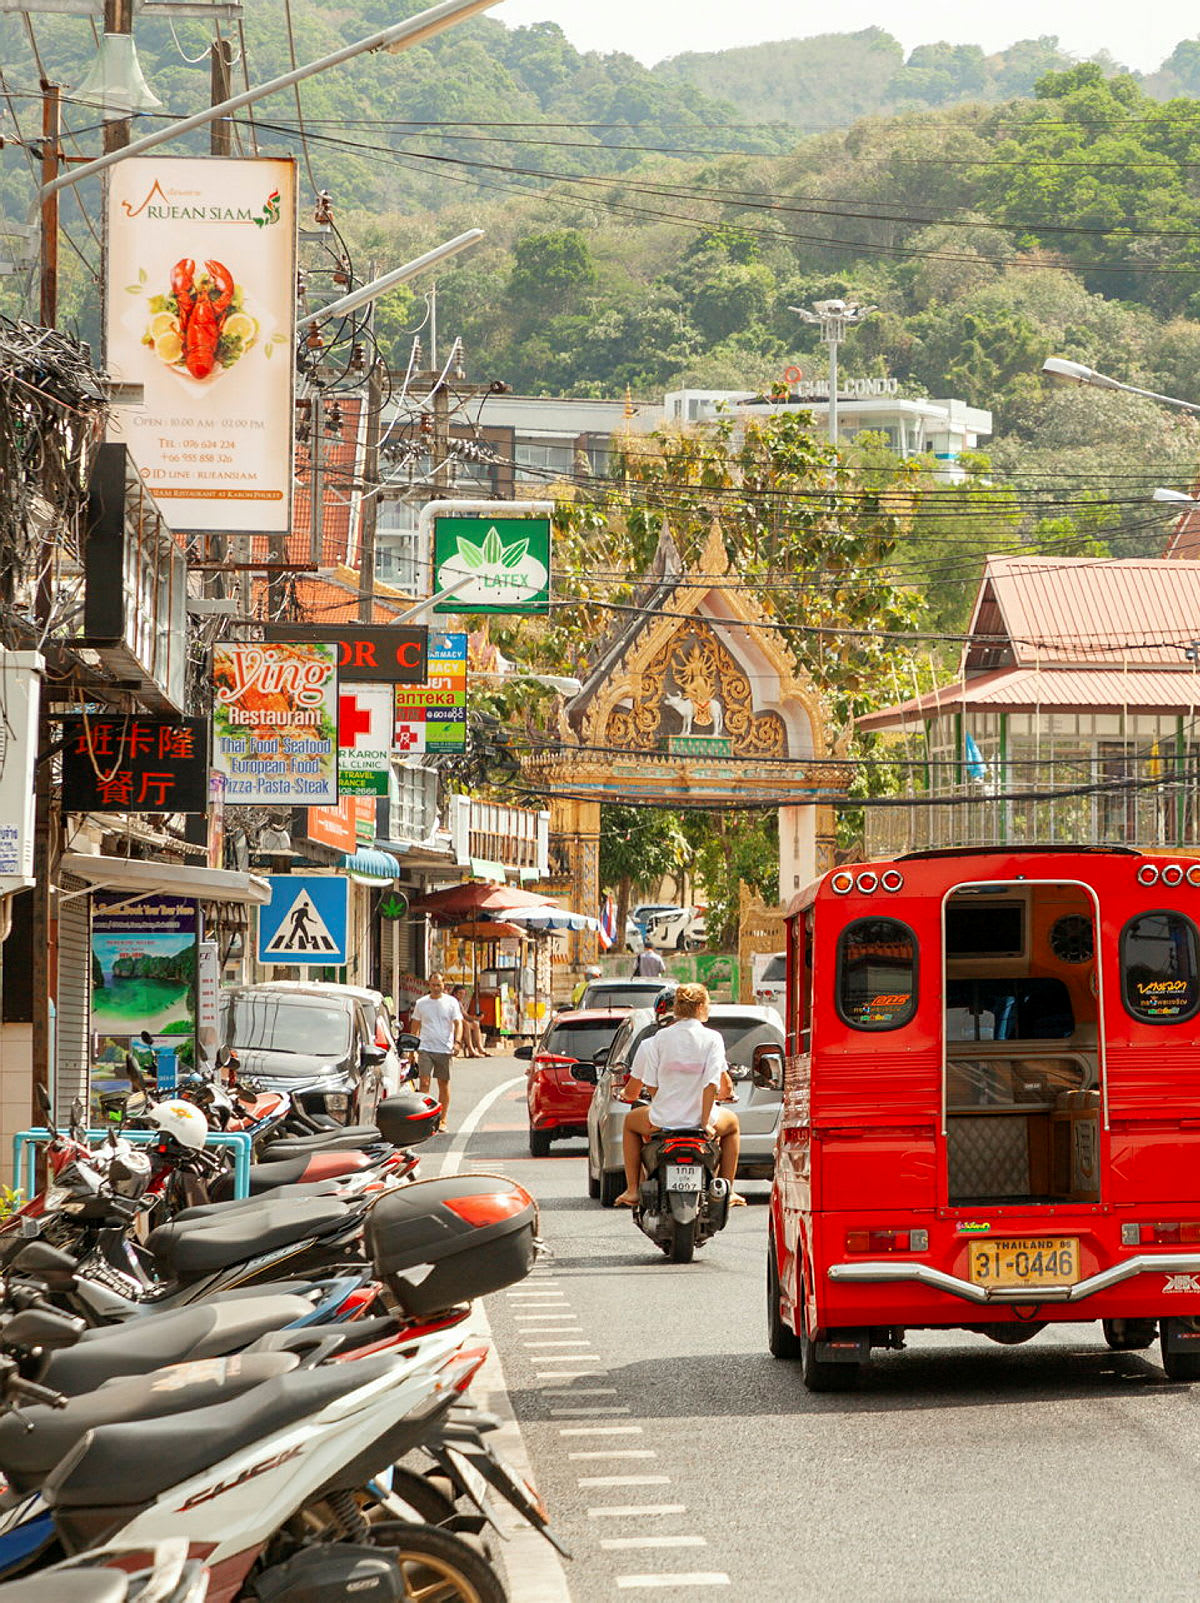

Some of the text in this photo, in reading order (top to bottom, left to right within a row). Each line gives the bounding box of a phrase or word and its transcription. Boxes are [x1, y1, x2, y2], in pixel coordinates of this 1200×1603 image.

[147, 206, 252, 220] RUEAN SIAM
[844, 378, 898, 395] CONDO
[484, 573, 529, 588] LATEX
[217, 648, 333, 708] Ying
[396, 692, 456, 705] аптека
[228, 707, 323, 726] Restaurant
[220, 738, 331, 754] Thai Food Seafood
[348, 748, 388, 759] KARON
[231, 757, 320, 775] European Food
[350, 761, 381, 769] CLINIC
[344, 771, 375, 779] TRAVEL
[95, 768, 176, 806] 餐厅
[994, 1240, 1054, 1249] THAILAND
[975, 1250, 1073, 1278] 31-0446
